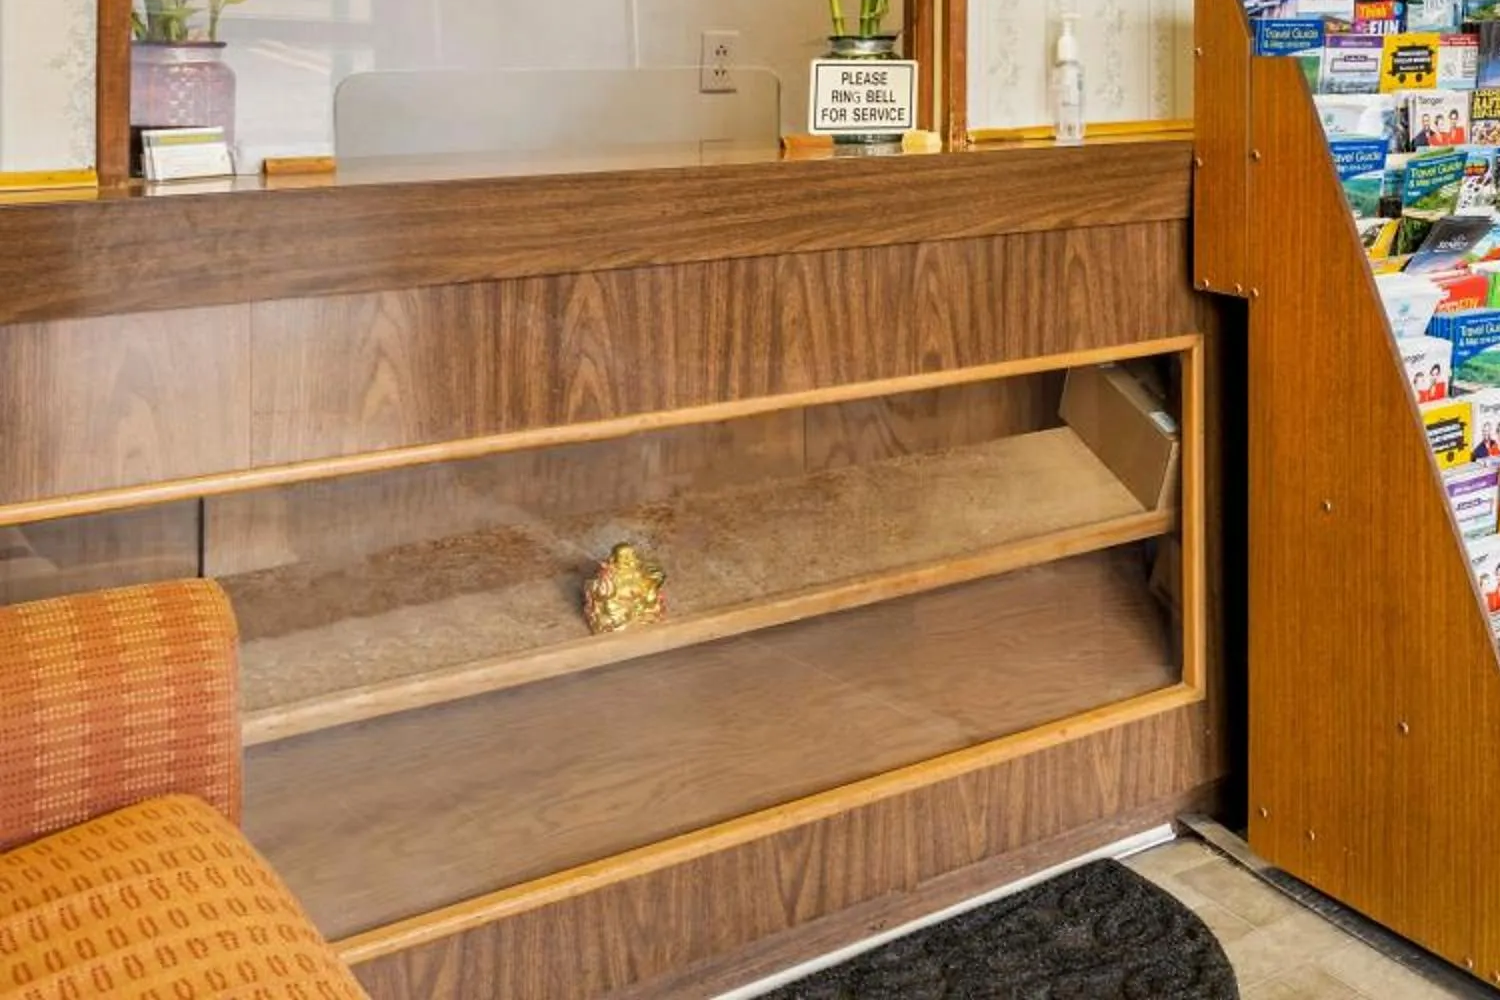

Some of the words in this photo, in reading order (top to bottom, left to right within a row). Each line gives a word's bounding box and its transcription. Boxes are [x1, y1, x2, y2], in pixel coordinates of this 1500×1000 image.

[1265, 27, 1291, 38] Travel
[1292, 27, 1319, 39] Guide
[841, 71, 888, 86] PLEASE
[831, 89, 862, 103] RING
[866, 89, 896, 103] BELL
[821, 107, 847, 121] FOR
[853, 107, 906, 121] SERVICE
[1355, 150, 1382, 162] Guide
[1410, 165, 1437, 179] Travel
[1438, 161, 1463, 175] Guide
[1460, 324, 1484, 337] Travel
